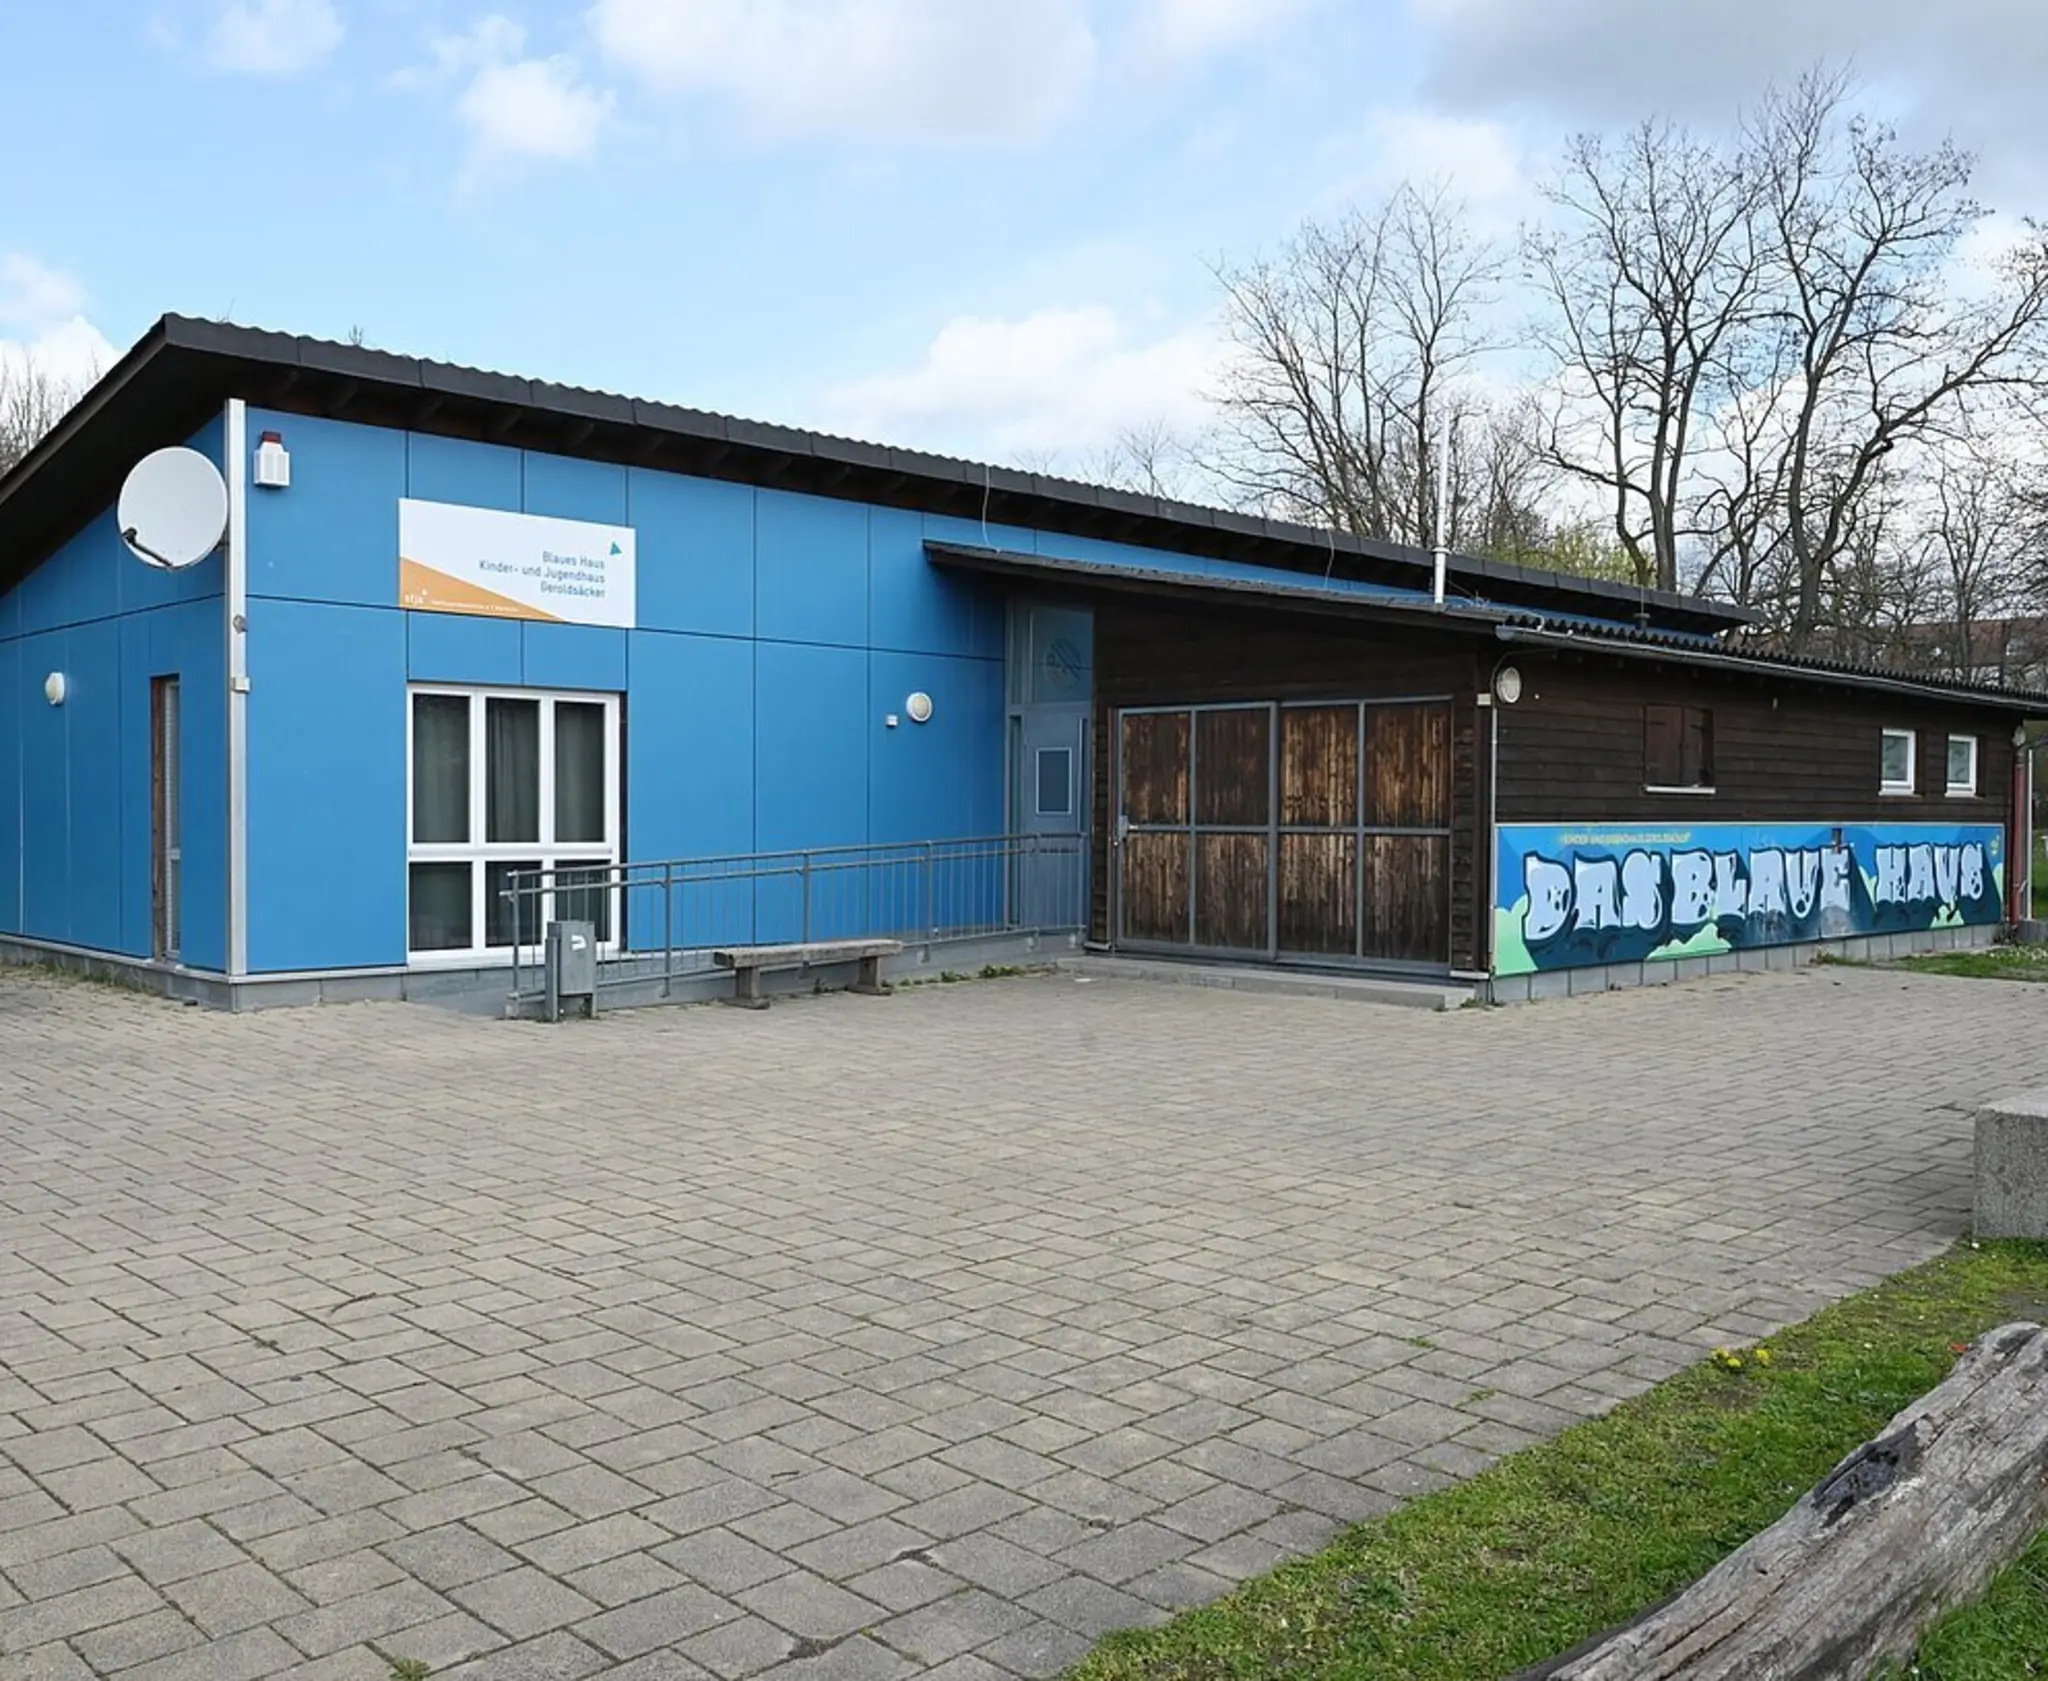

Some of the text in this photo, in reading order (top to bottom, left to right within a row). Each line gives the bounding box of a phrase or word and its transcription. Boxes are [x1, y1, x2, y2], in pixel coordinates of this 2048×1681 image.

[542, 550, 605, 569] Blaues Haus
[479, 559, 605, 583] Kinder- und Jugendhaus
[540, 580, 605, 597] Geroldsäcker
[1523, 850, 1663, 942] DAS
[1670, 848, 1850, 924] BLAUE
